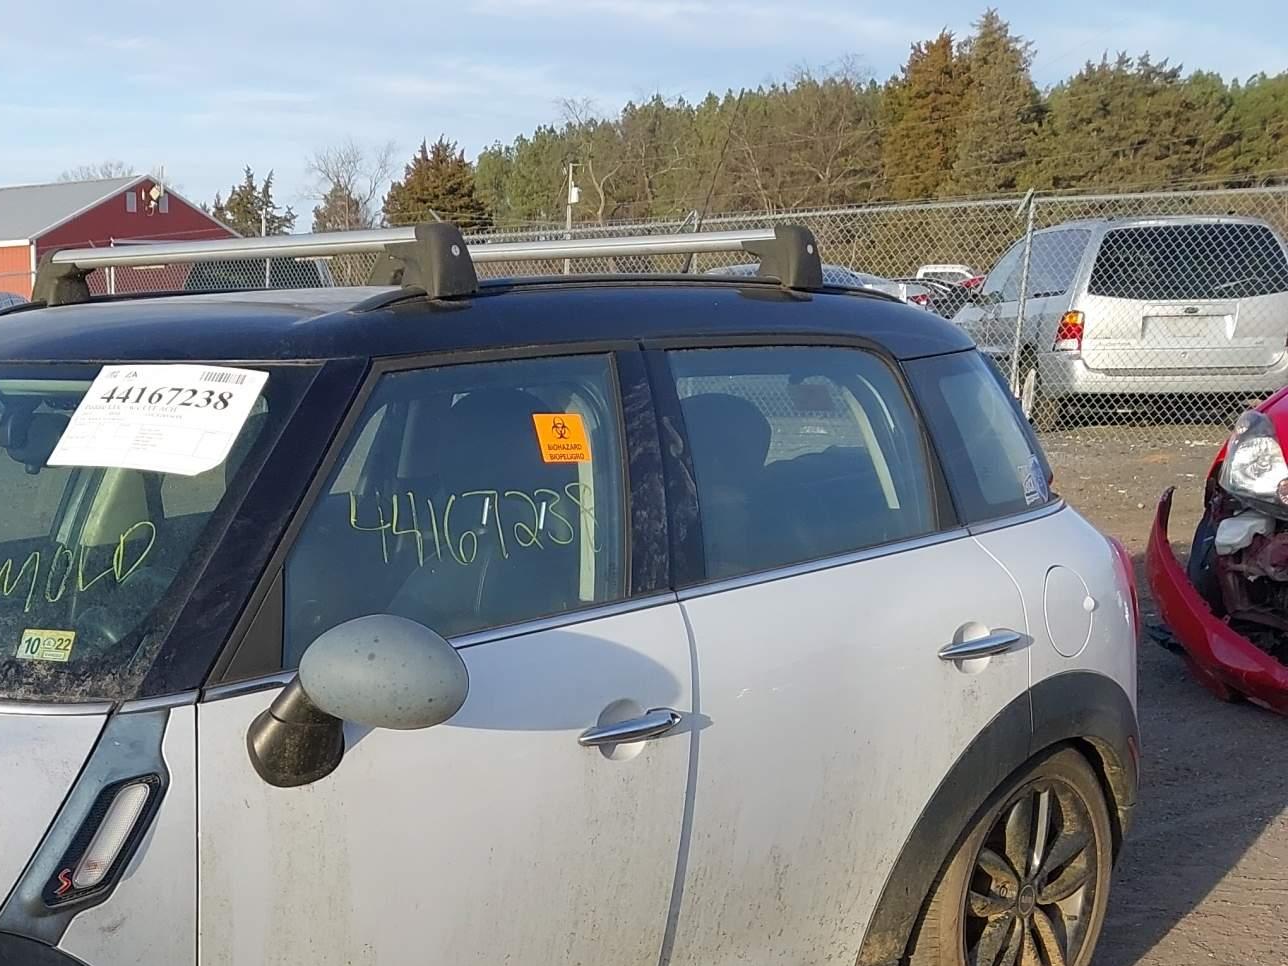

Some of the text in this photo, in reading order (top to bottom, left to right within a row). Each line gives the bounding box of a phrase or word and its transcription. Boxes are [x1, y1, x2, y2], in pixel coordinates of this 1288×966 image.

[100, 385, 234, 411] 44167238
[349, 482, 602, 568] 44167238
[24, 636, 72, 655] 10 22
[54, 867, 72, 896] S
